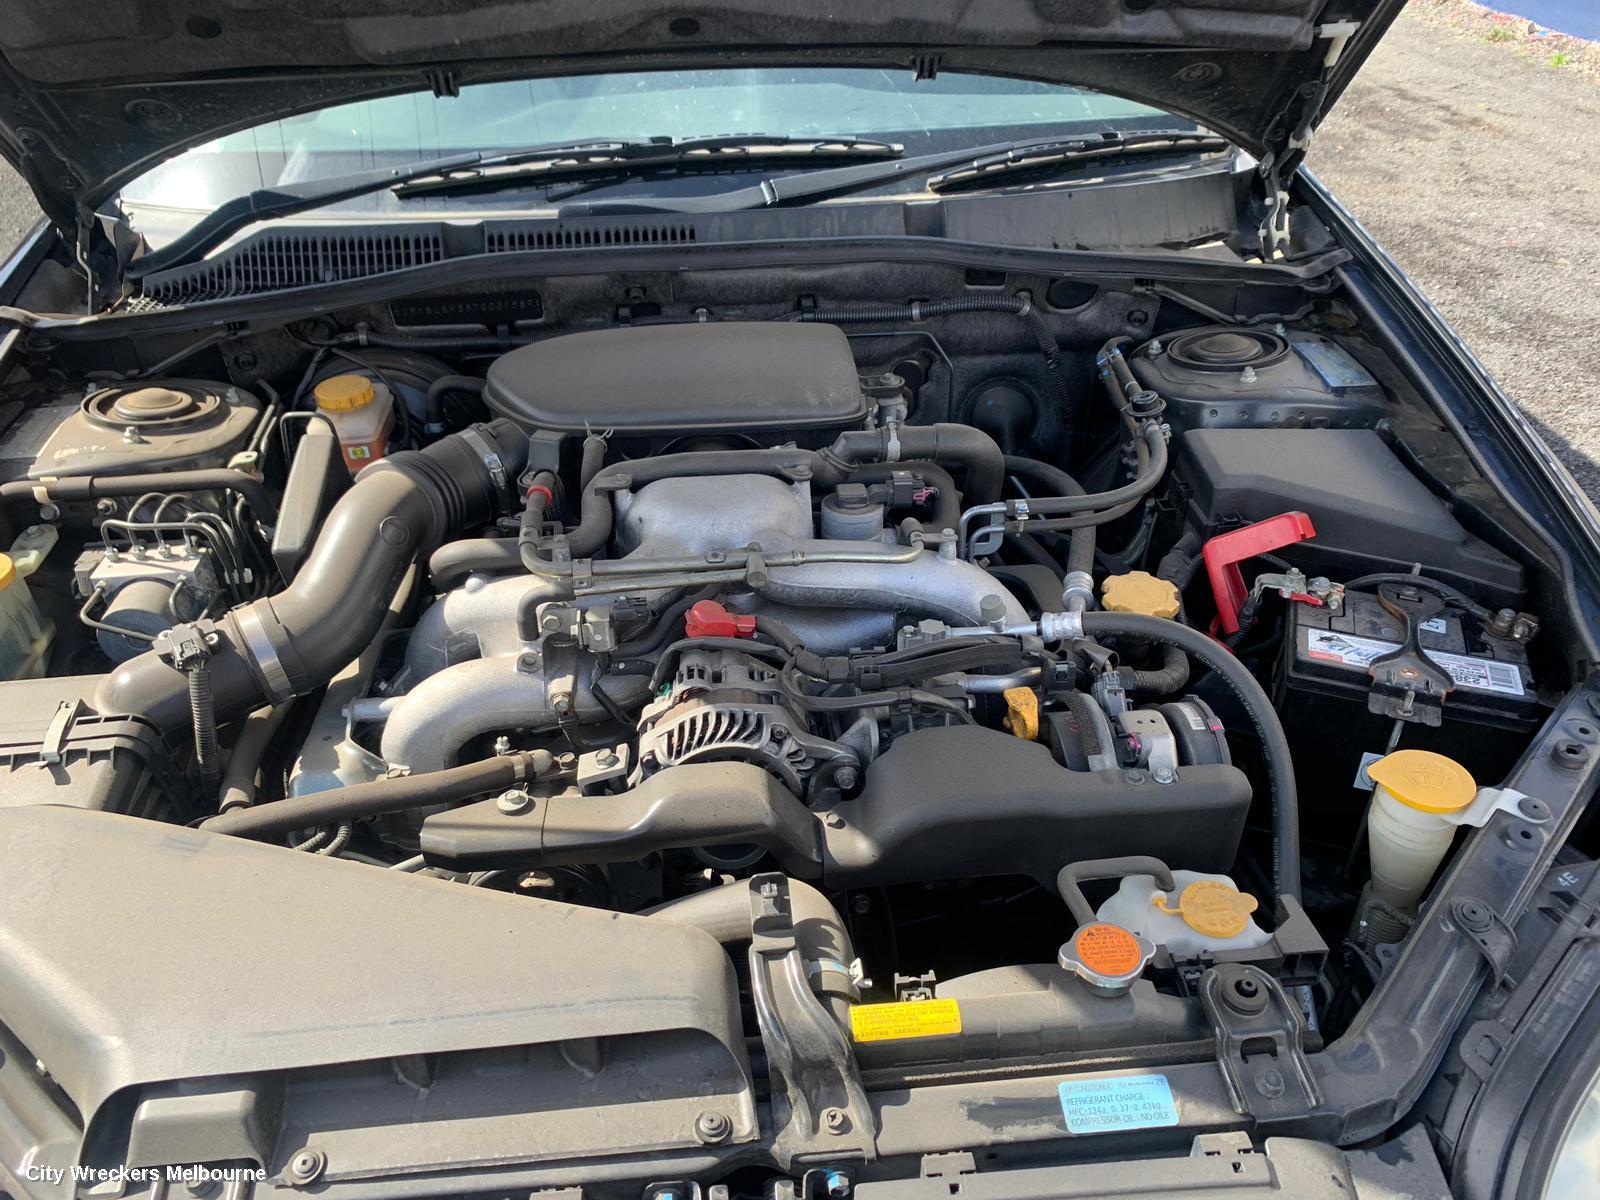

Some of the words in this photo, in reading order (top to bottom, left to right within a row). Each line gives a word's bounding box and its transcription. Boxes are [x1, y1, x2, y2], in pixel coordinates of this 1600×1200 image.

[1066, 1094, 1114, 1106] REFRIGERANT
[1115, 1092, 1145, 1102] CHARGE
[1071, 1115, 1120, 1127] COMPRESSOR
[1123, 1114, 1136, 1123] OIL
